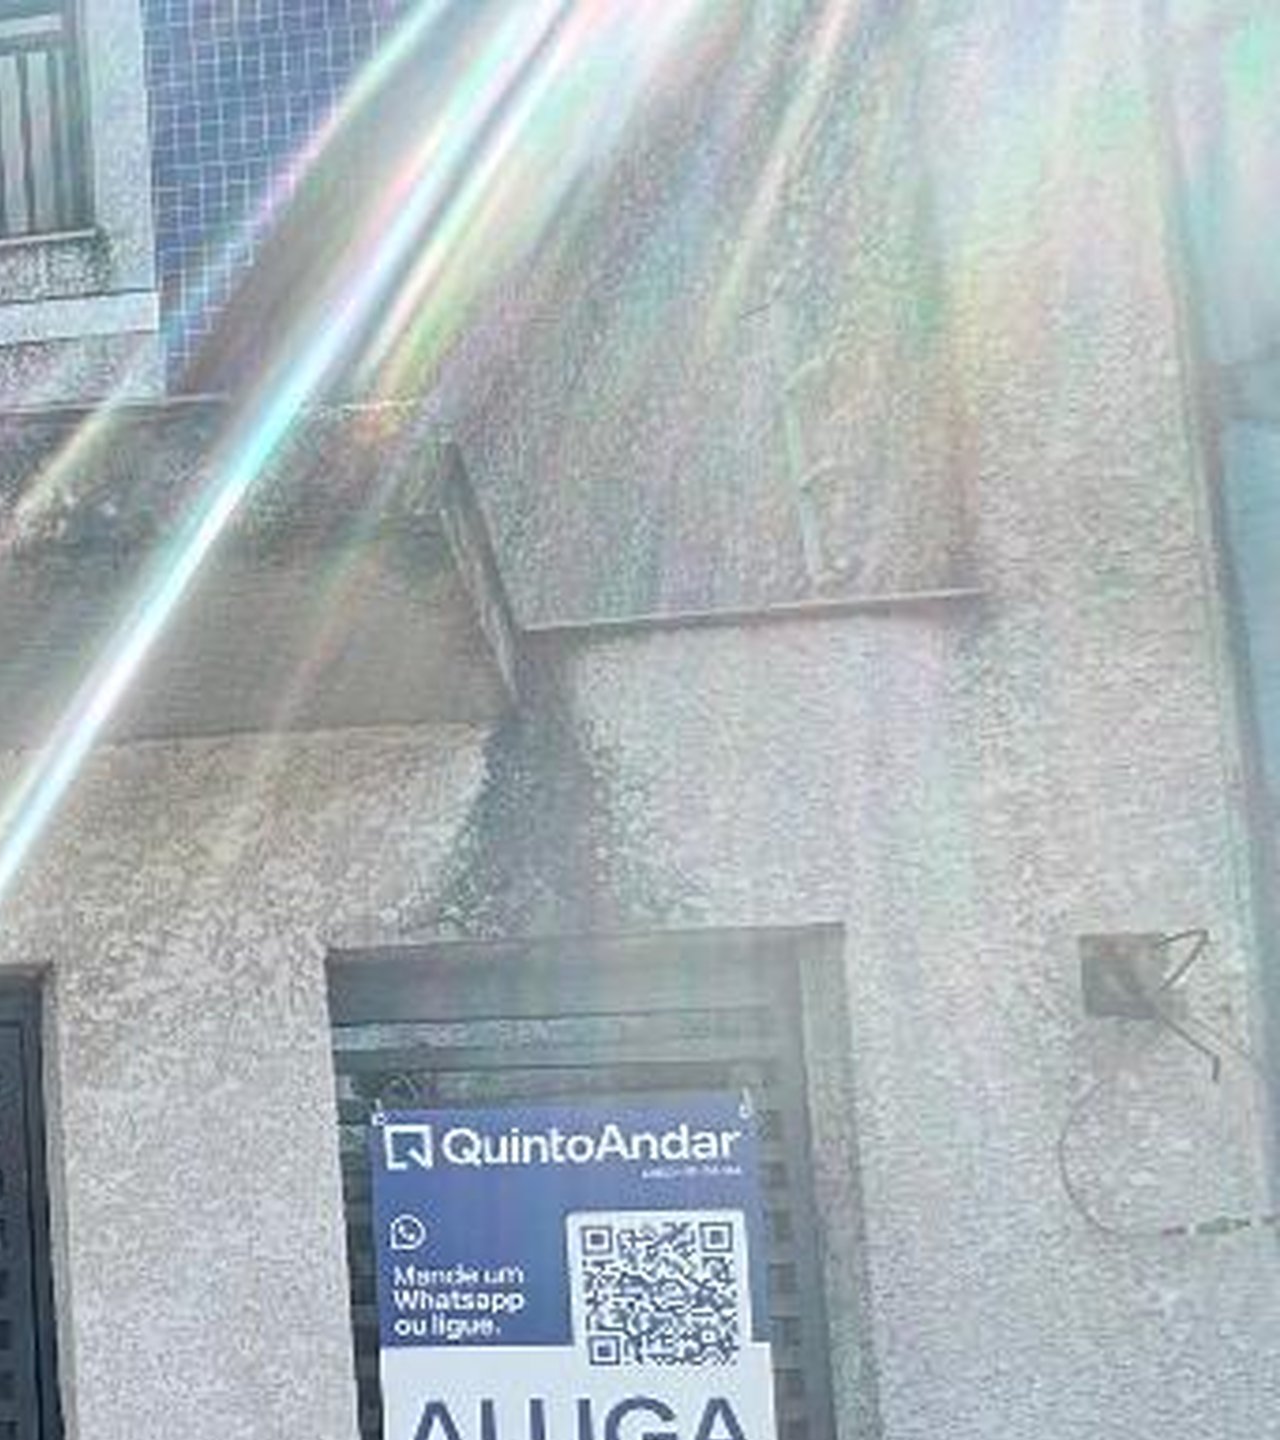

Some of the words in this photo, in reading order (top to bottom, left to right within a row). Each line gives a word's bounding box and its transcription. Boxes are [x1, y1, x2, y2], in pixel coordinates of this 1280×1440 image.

[442, 1123, 741, 1165] QuintoAndar
[393, 1264, 478, 1286] Mande
[483, 1266, 523, 1284] um
[393, 1289, 524, 1313] Whatsapp
[394, 1319, 426, 1336] ou
[431, 1313, 501, 1339] ligue.
